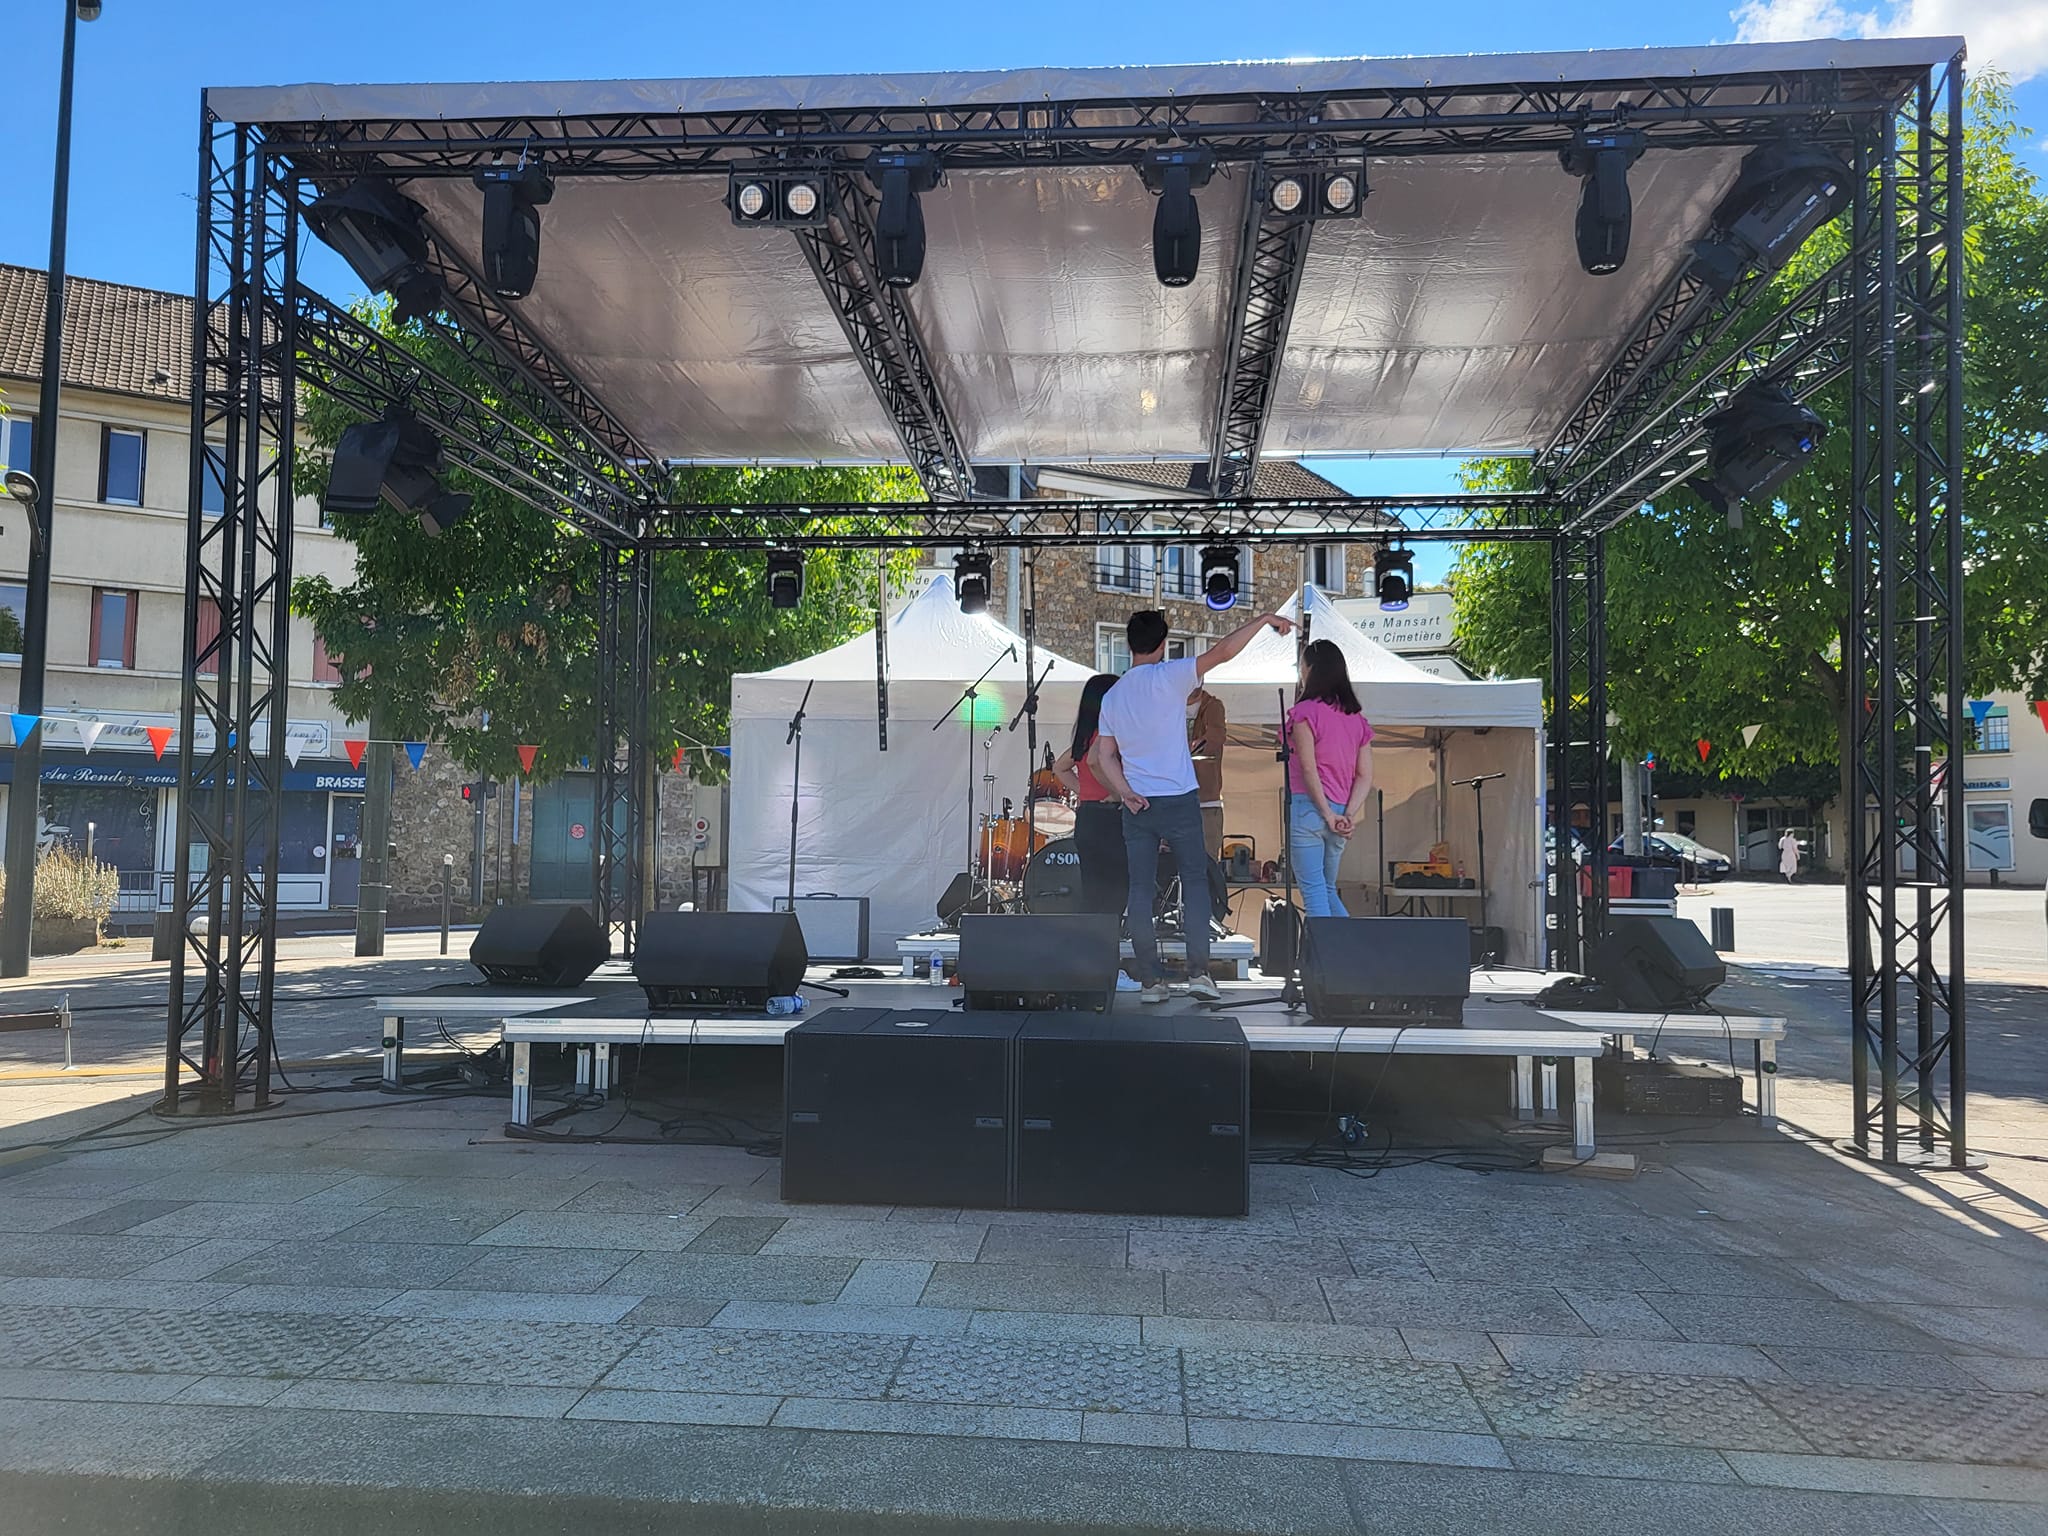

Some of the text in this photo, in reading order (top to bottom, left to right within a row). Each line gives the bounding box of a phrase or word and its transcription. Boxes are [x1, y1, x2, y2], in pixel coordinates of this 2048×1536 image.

[1383, 616, 1440, 628] Mansart
[1383, 630, 1442, 643] Cimetière
[40, 767, 70, 781] Au
[73, 767, 178, 786] Rendez-vous
